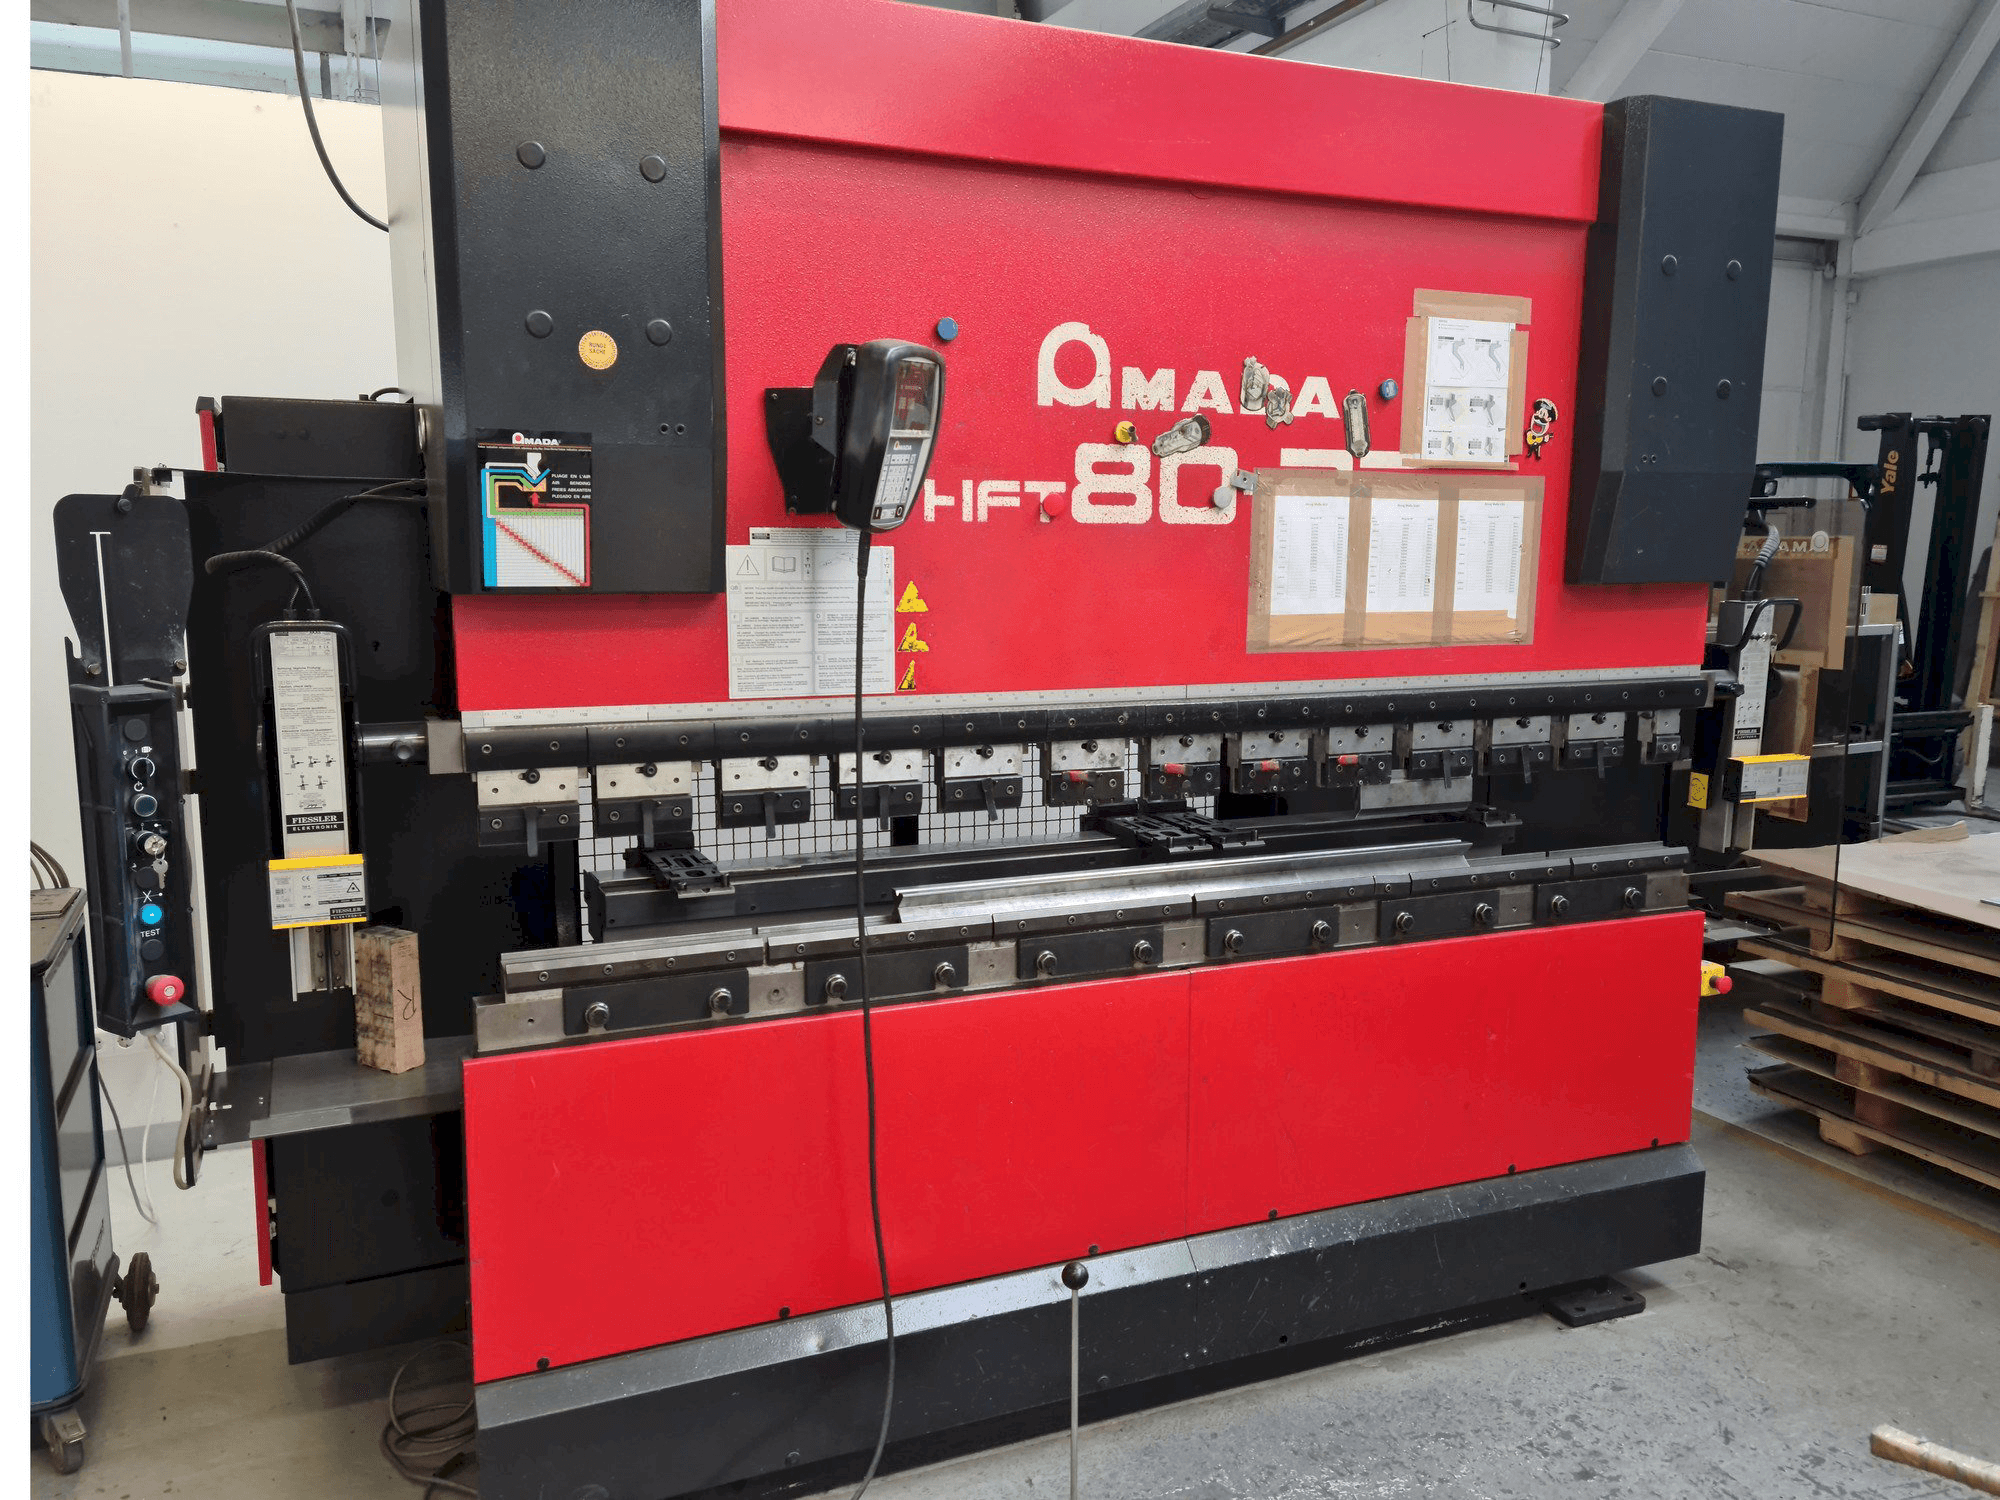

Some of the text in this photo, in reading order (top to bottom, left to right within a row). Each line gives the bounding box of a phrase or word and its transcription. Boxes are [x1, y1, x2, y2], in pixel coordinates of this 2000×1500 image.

[512, 432, 560, 446] AMADA
[1880, 450, 1899, 494] Yale
[292, 815, 338, 824] FIESSLER
[140, 928, 161, 938] TEST
